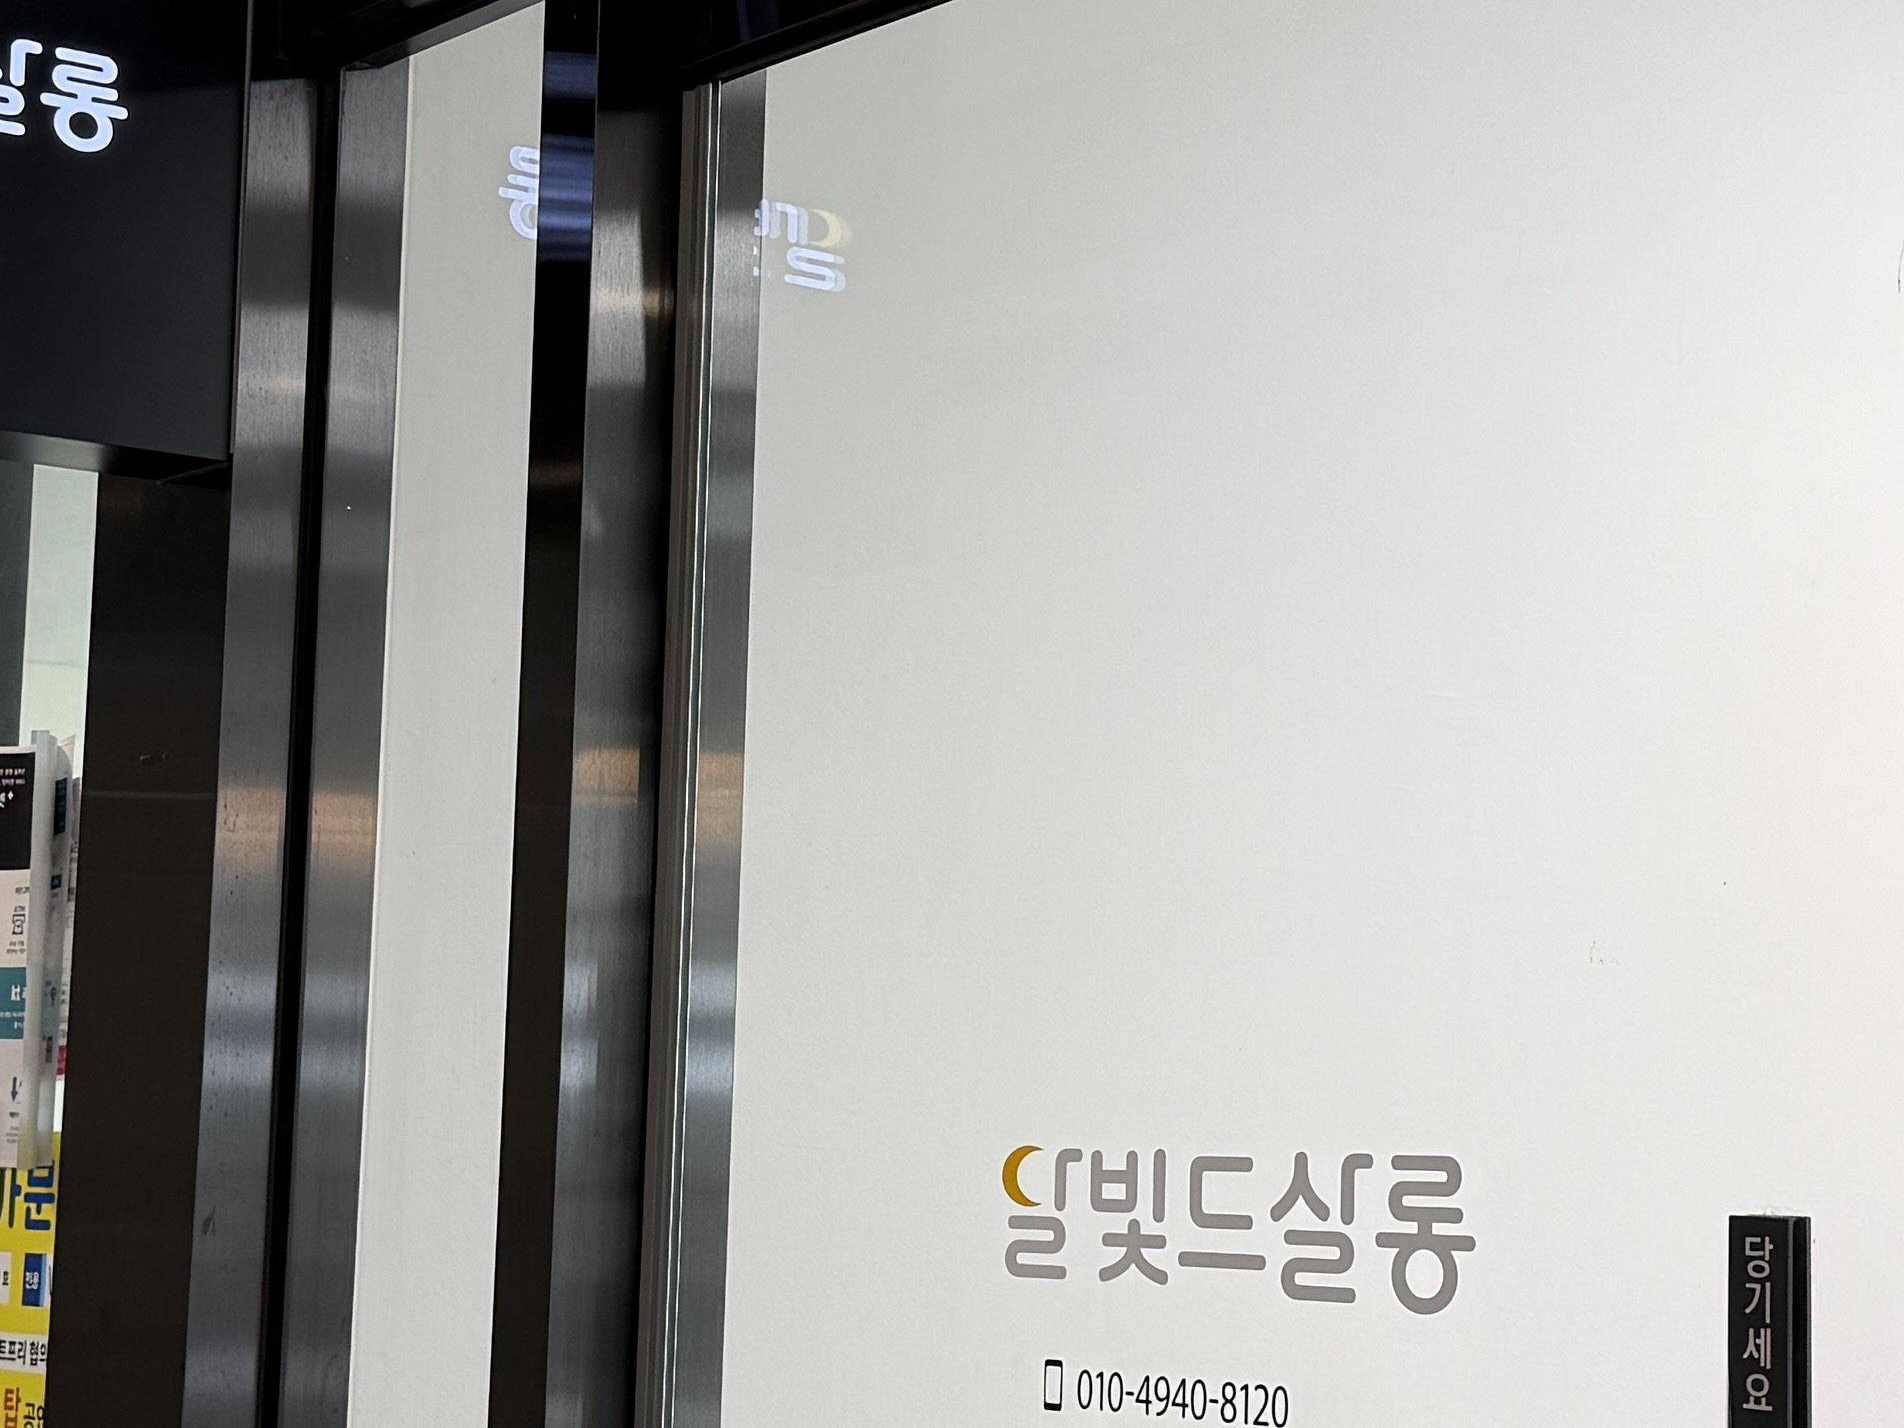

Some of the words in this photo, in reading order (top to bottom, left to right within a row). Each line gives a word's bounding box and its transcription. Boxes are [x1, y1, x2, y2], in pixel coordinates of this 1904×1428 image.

[1002, 1144, 1476, 1315] 달빛드살롱
[1077, 1369, 1290, 1428] 010-4940-8120
[1742, 1236, 1774, 1412] 당기세요
